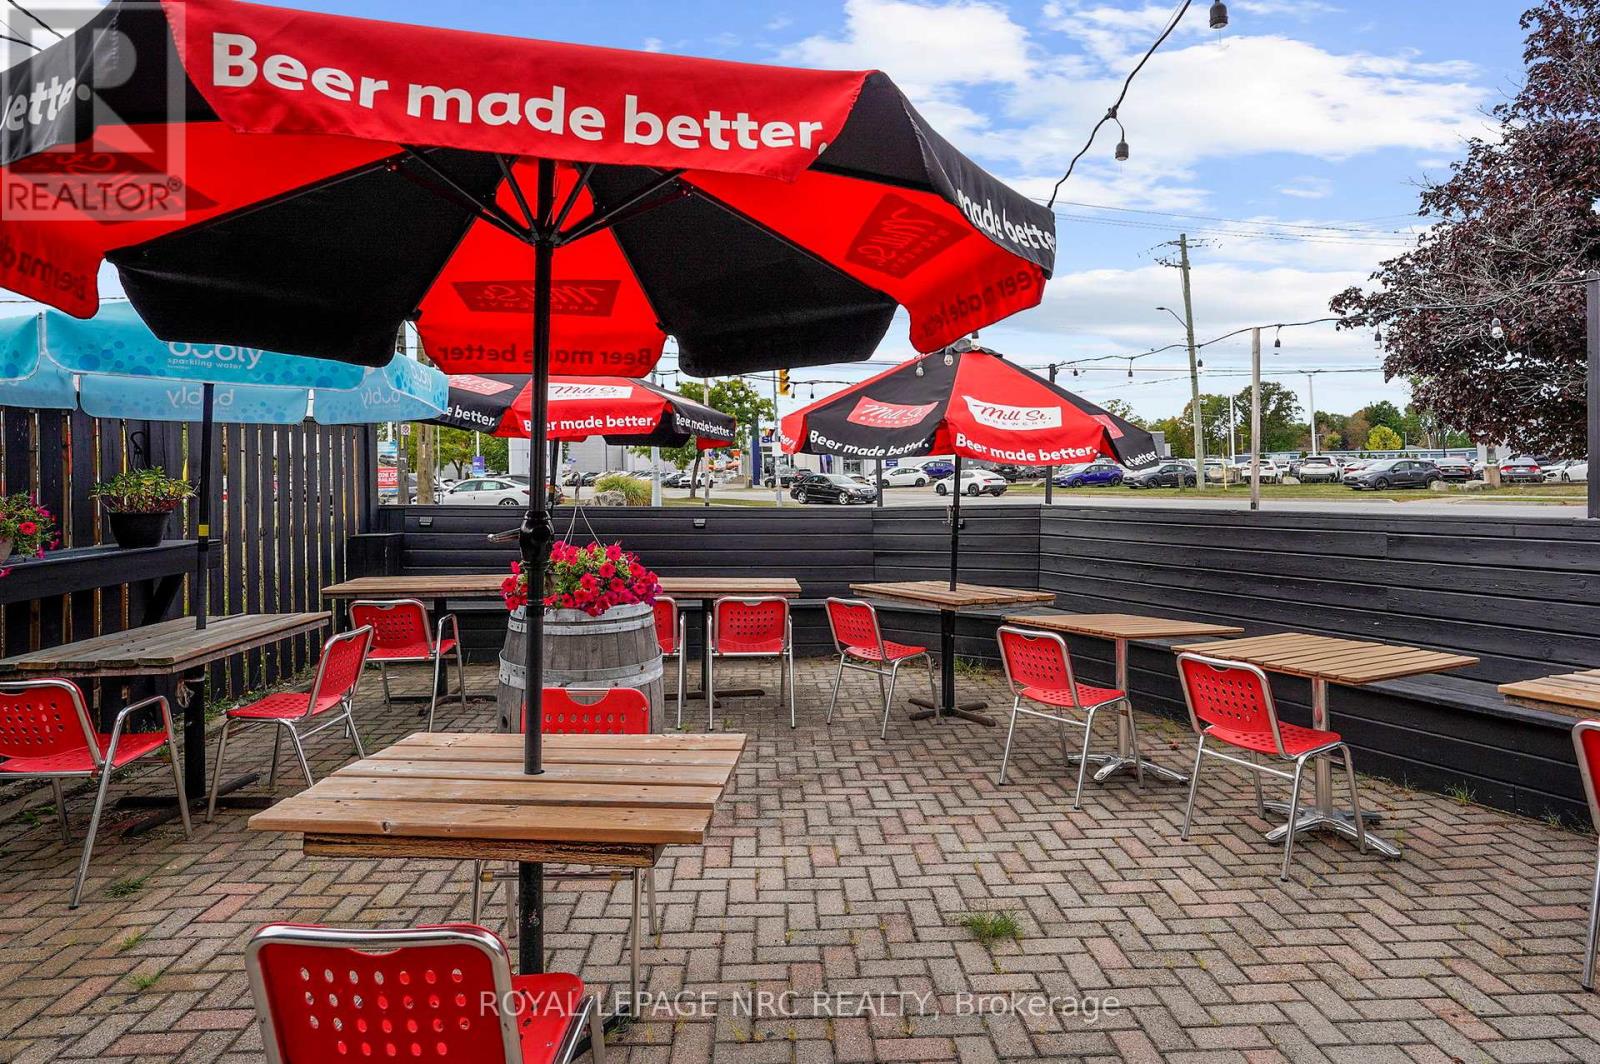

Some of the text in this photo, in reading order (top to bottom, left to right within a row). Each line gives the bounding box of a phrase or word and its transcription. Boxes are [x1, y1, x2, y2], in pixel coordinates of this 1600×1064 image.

[212, 32, 828, 155] Beer made better.
[454, 405, 495, 427] better.
[523, 414, 657, 432] Ber made better.
[971, 403, 1053, 422] Mill St.
[810, 430, 842, 450] Beer
[843, 443, 886, 457] made
[956, 433, 1098, 462] Beer made better.
